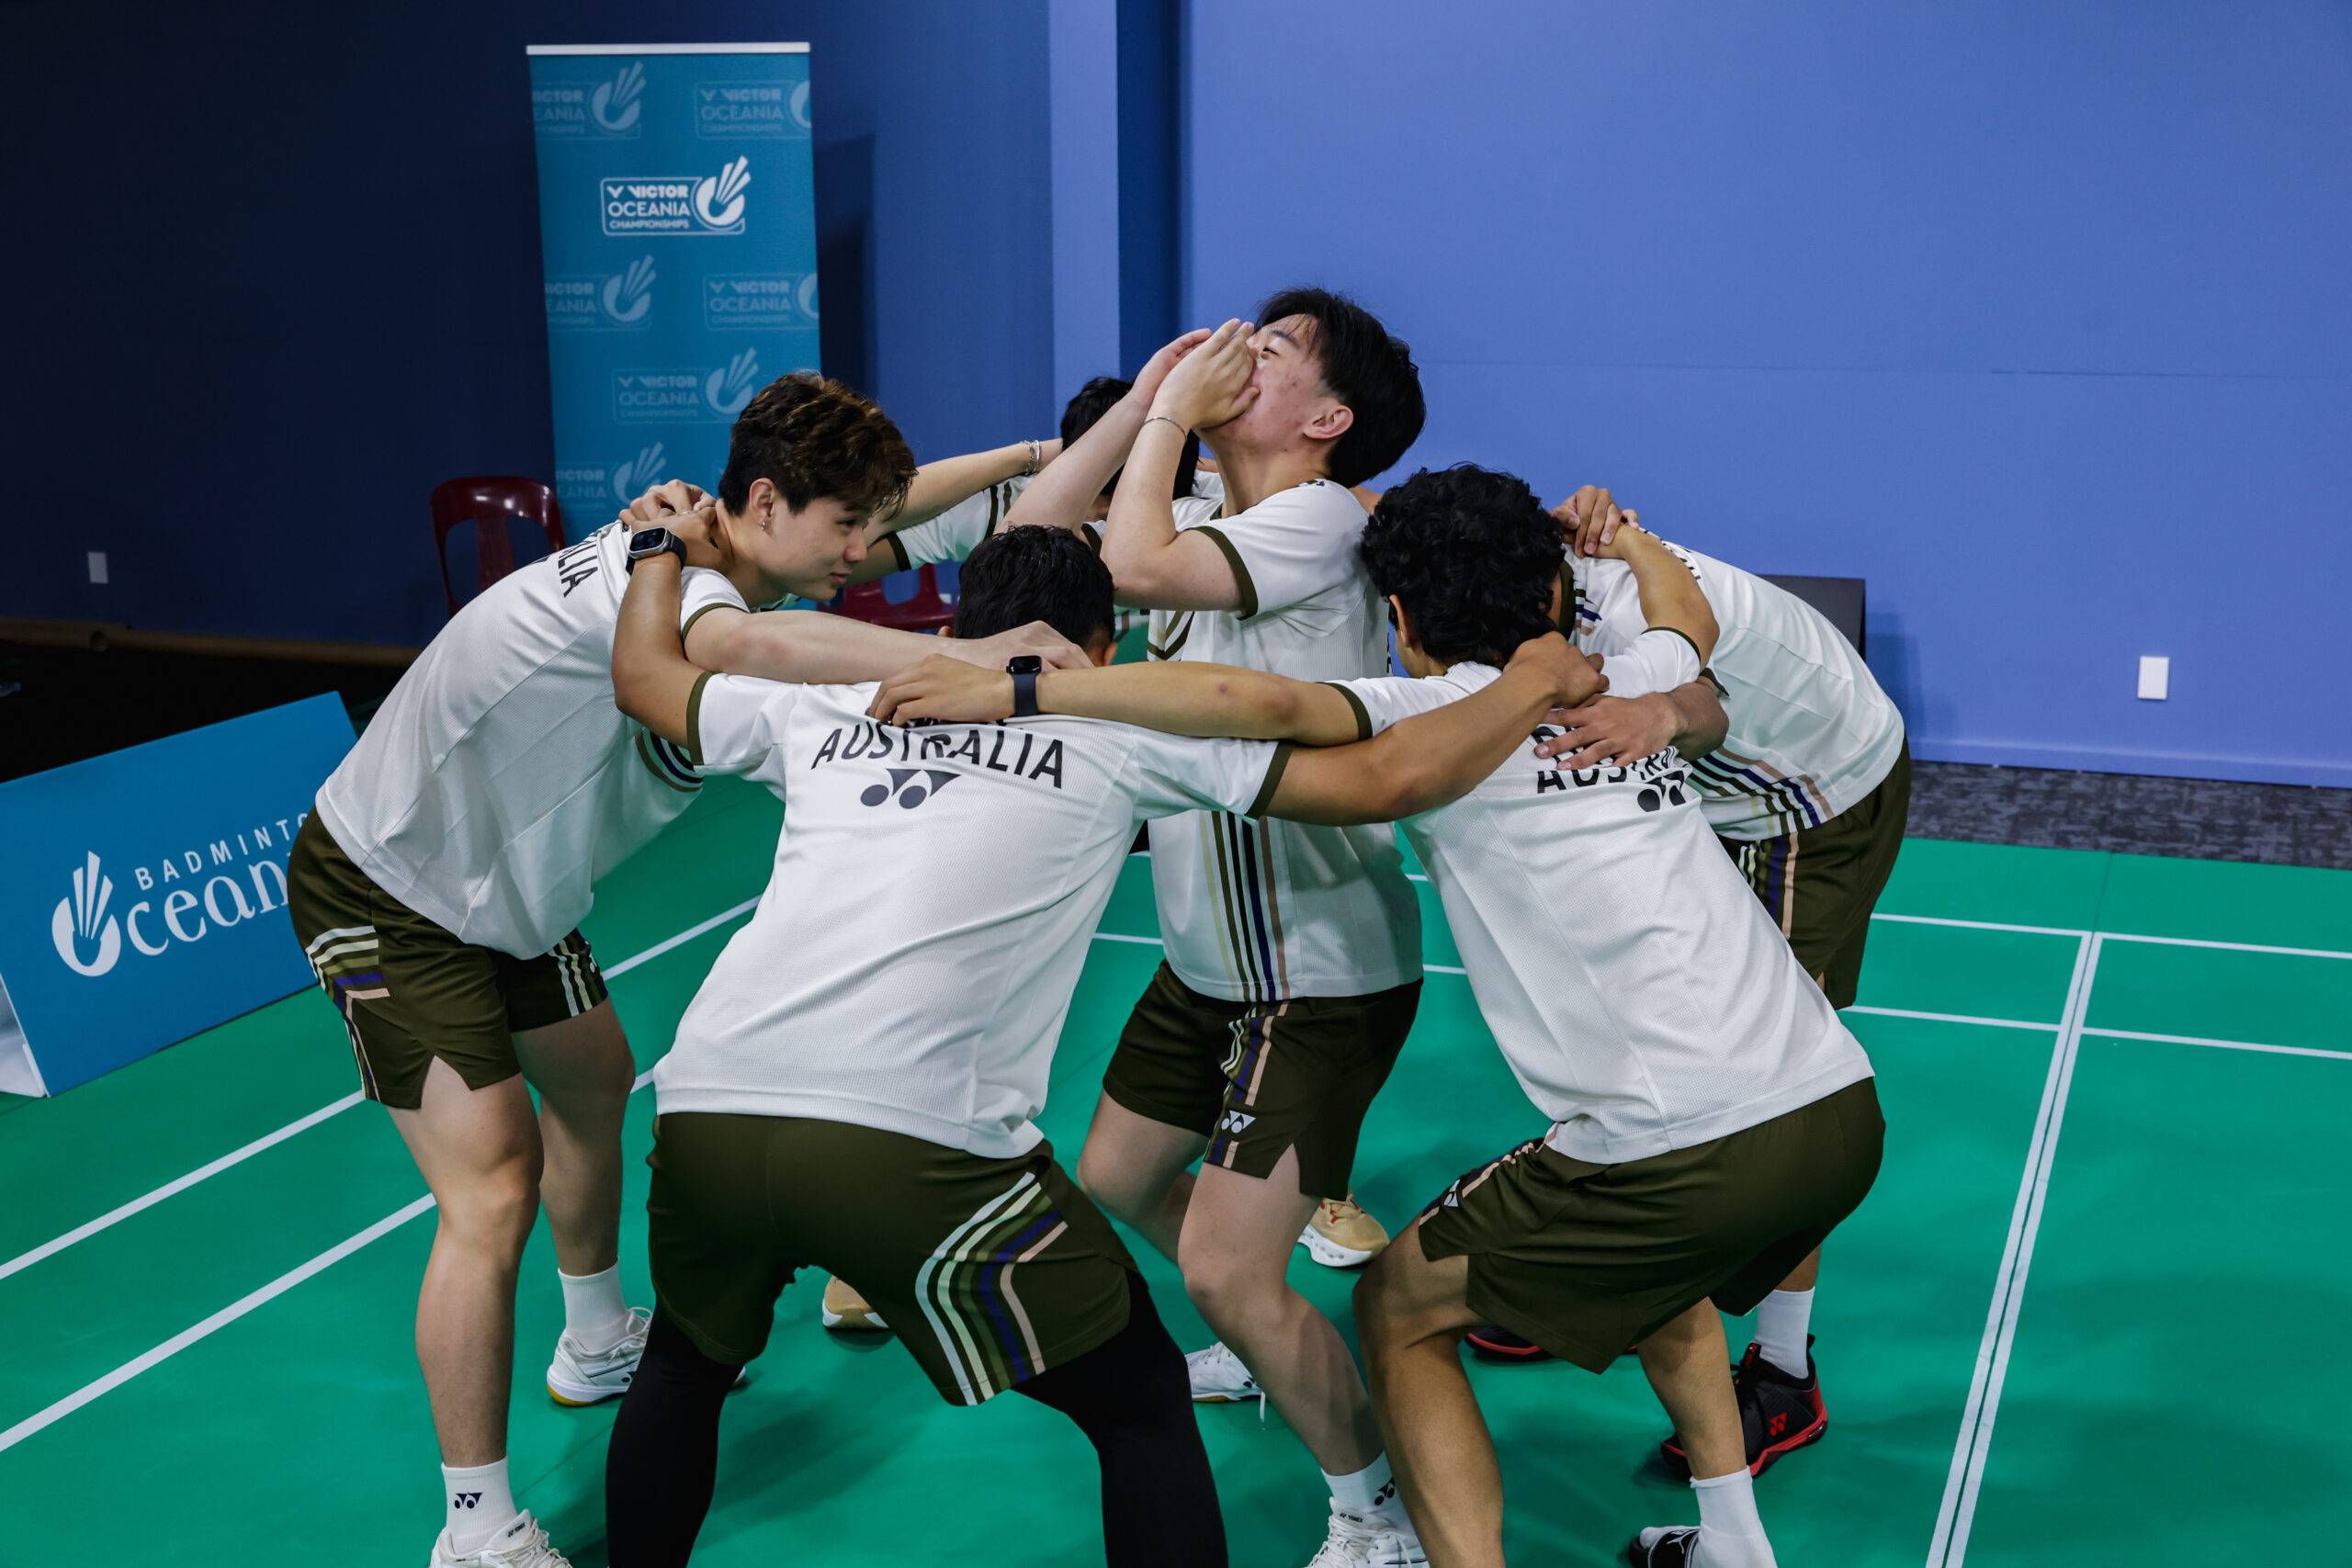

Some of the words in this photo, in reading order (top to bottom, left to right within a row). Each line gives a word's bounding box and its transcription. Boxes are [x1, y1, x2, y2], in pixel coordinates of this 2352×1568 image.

[720, 89, 782, 102] VICTOR
[701, 106, 785, 121] OCEANIA
[628, 185, 689, 198] VICTOR
[607, 201, 691, 217] OCEANIA
[730, 281, 790, 293] VICTOR
[710, 297, 792, 312] OCEANIA
[639, 375, 697, 388] VICTOR
[618, 390, 700, 405] OCEANIA
[810, 721, 1063, 789] AUSTRALIA
